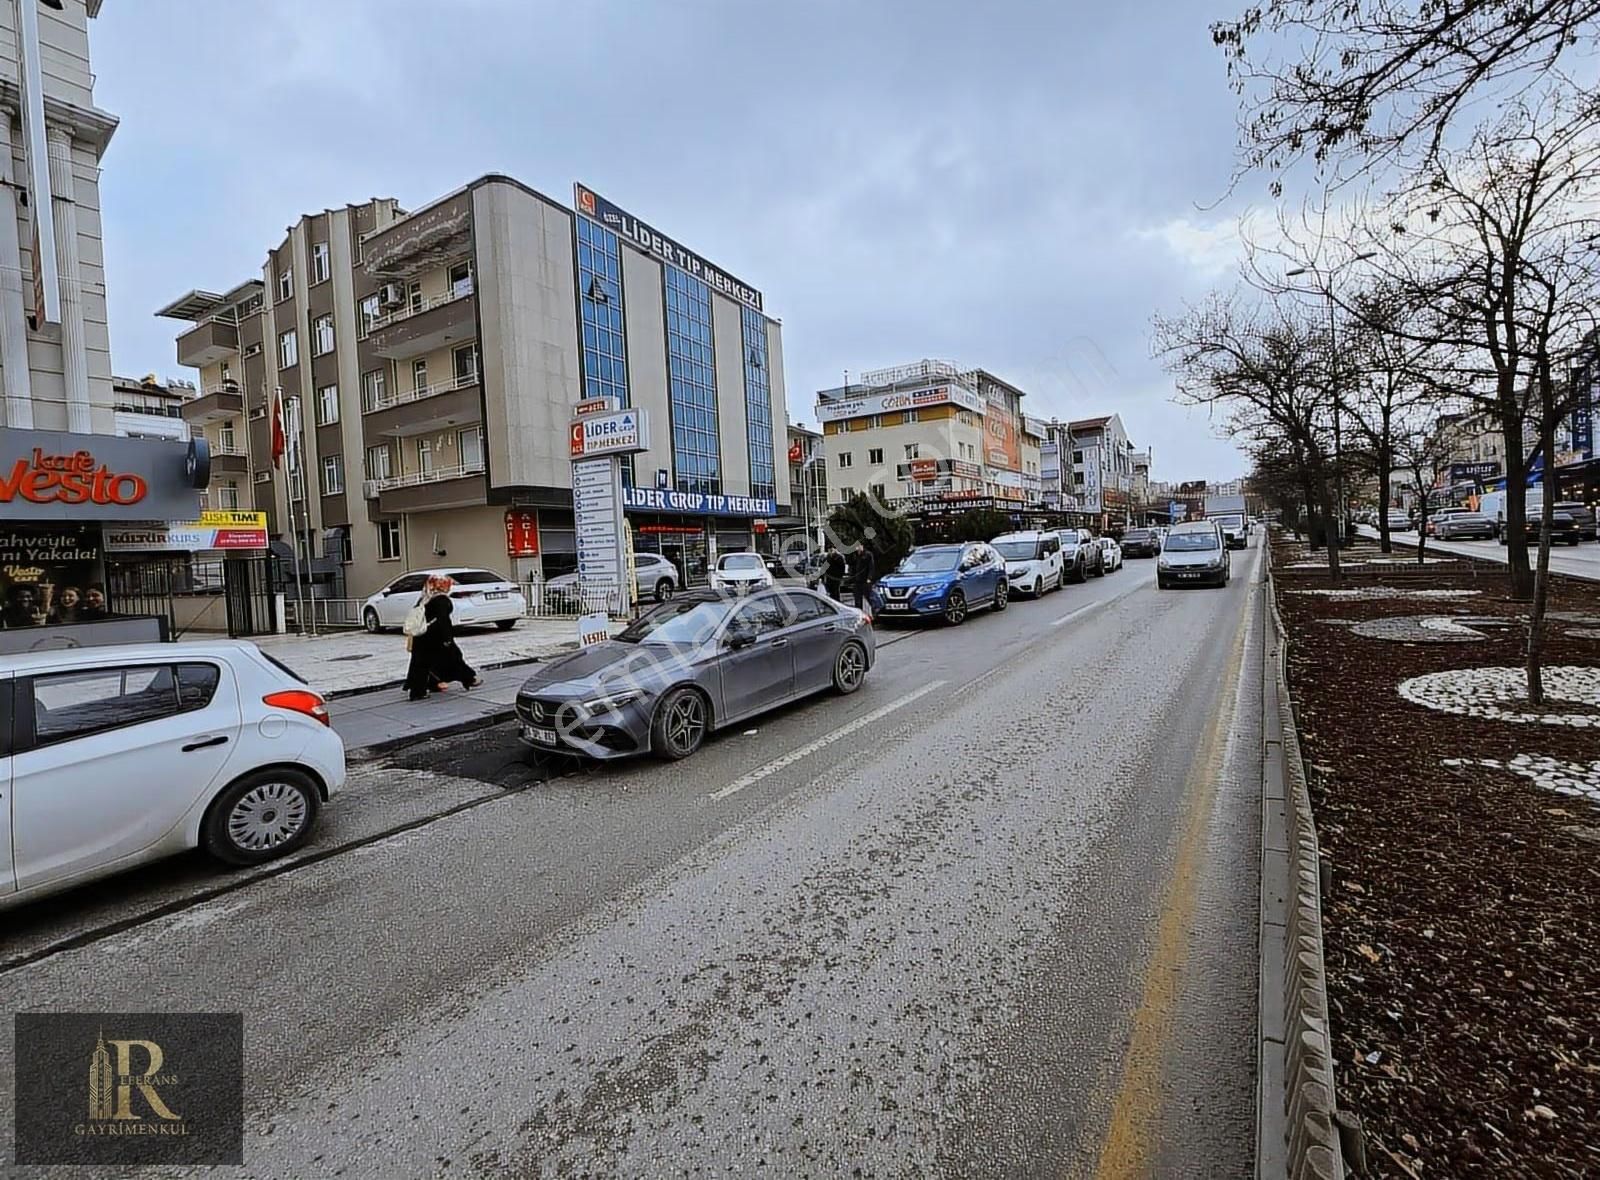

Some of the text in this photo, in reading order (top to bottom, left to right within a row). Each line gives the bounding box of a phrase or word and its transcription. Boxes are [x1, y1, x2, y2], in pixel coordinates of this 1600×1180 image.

[621, 216, 674, 259] LİDER
[677, 248, 701, 274] TIP
[704, 268, 761, 308] MERKEZİ
[585, 421, 617, 438] LİDER
[599, 431, 636, 447] MERKEZİ
[624, 487, 770, 513] LİDER GRUP TIP MERKEZİ
[230, 513, 259, 522] TIME
[0, 533, 76, 549] ahveyle
[109, 532, 200, 544] KÜLTÜR KURS
[26, 547, 97, 561] Yakala!
[582, 630, 608, 645] VESTEL
